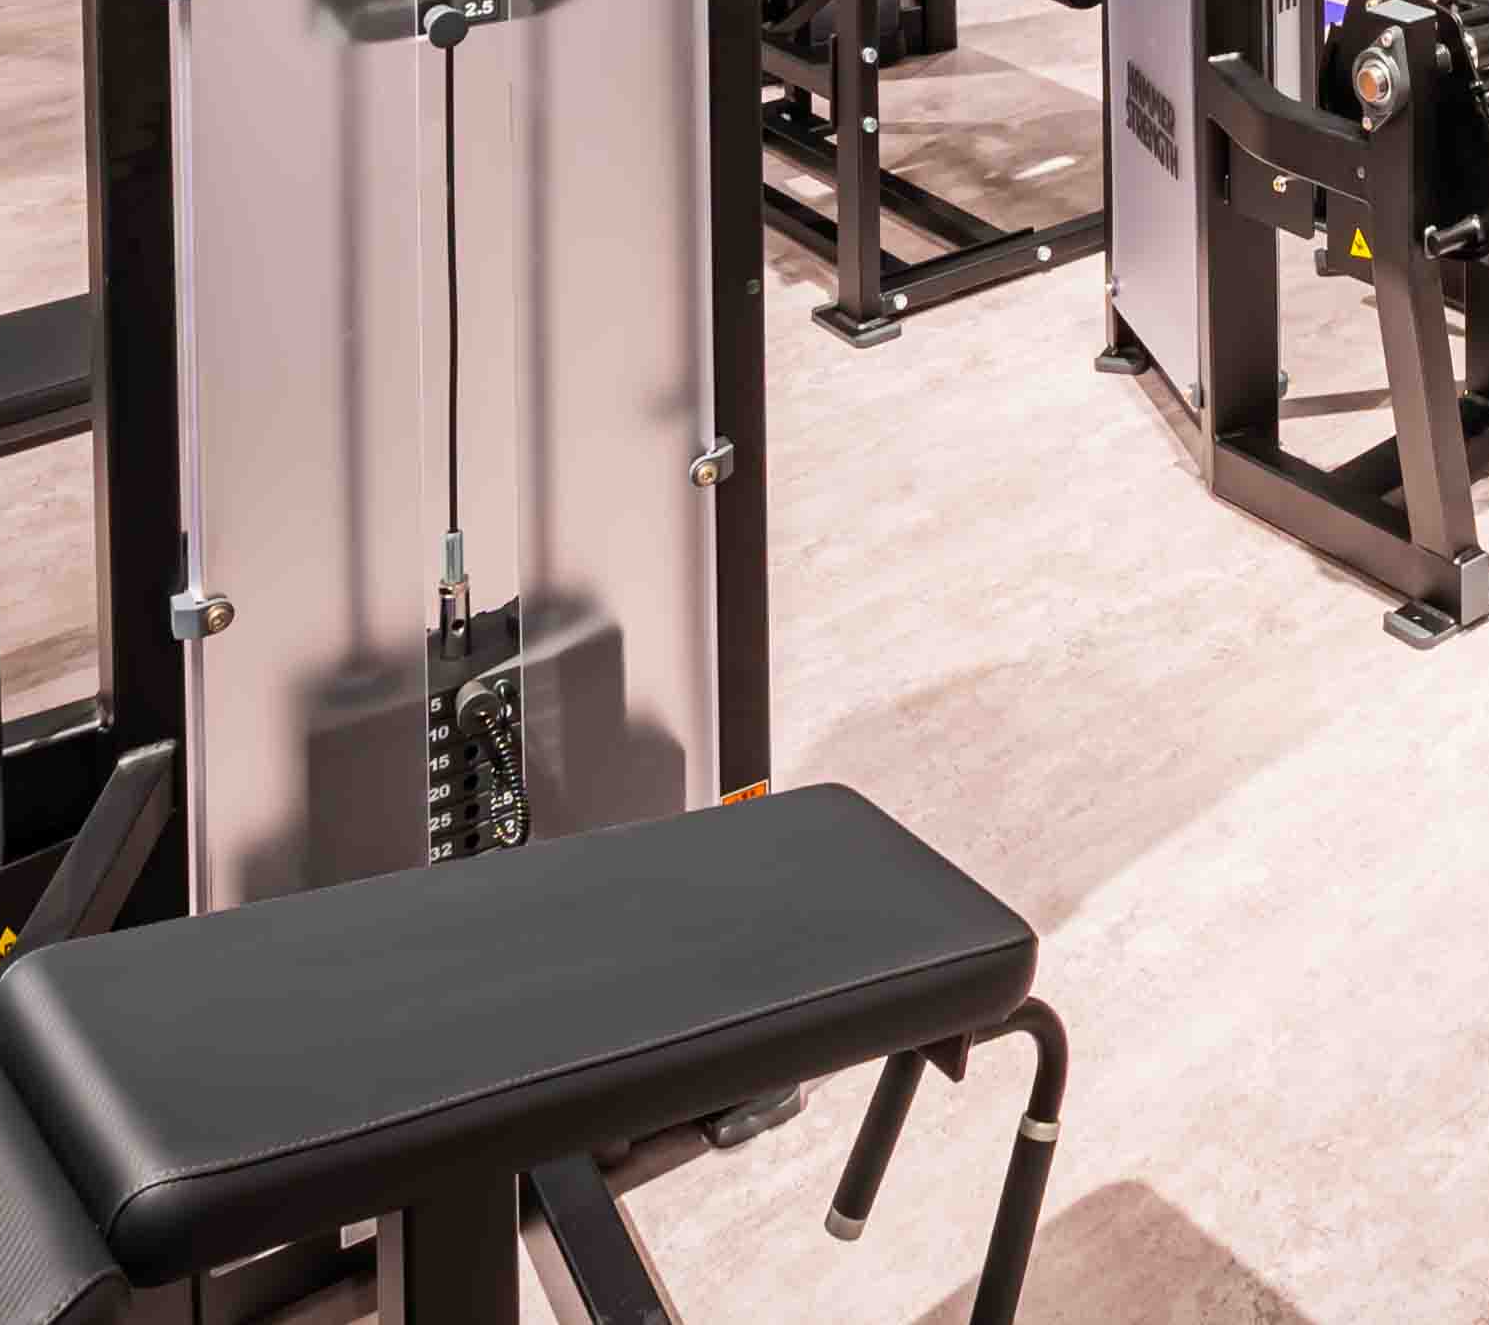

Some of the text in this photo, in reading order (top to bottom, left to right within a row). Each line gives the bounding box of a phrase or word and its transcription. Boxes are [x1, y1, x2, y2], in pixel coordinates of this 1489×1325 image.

[463, 0, 495, 18] 2.5
[1126, 58, 1176, 142] HAMMER
[1125, 94, 1179, 182] STRENGTH
[430, 697, 443, 713] 5
[428, 725, 450, 743] 10
[428, 753, 451, 773] 15
[428, 783, 451, 803] 20
[429, 811, 453, 832] 25
[430, 841, 453, 862] 32
